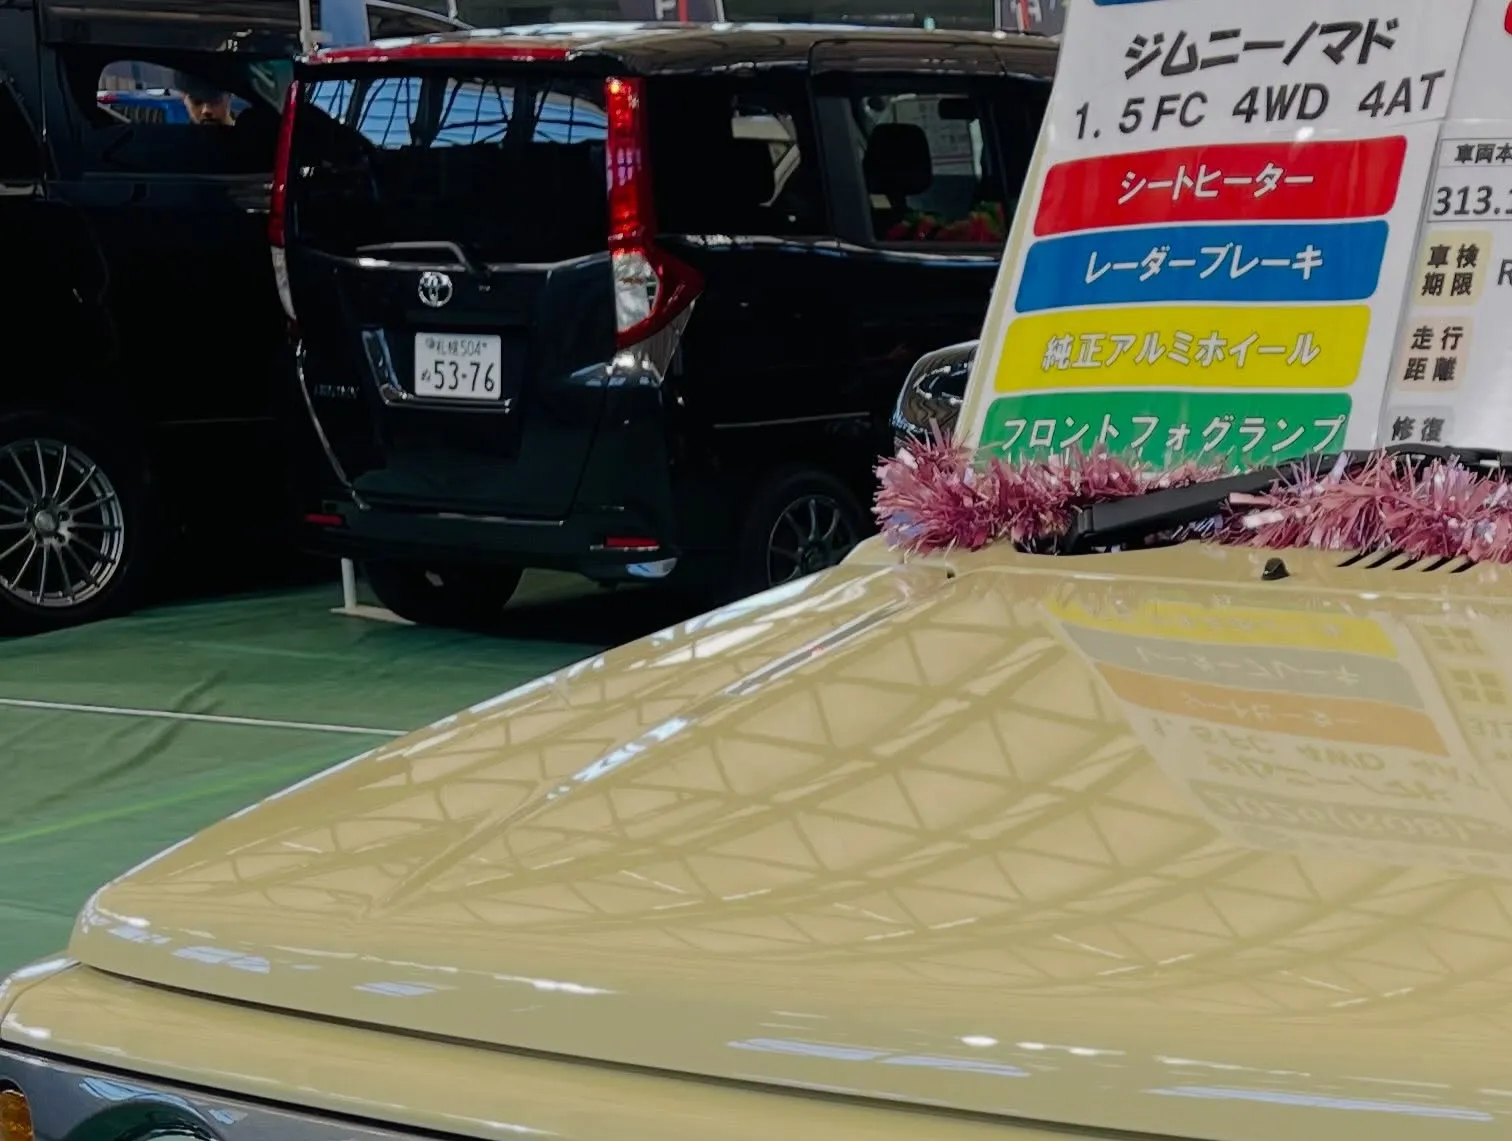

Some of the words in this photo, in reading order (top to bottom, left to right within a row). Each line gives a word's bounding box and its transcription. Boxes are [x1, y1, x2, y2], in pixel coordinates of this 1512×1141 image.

[1232, 82, 1331, 123] 4WD
[1358, 69, 1446, 118] 4AT
[1118, 162, 1314, 205] シートヒーター
[1085, 241, 1323, 285] レーダーブレーキ
[1427, 242, 1480, 268] 車検
[1421, 272, 1474, 297] 期限
[1041, 331, 1321, 371] 純正アルミホイール
[1410, 325, 1464, 351] 走行
[1403, 357, 1457, 382] 距離
[1001, 411, 1346, 455] フロントフォグランプ
